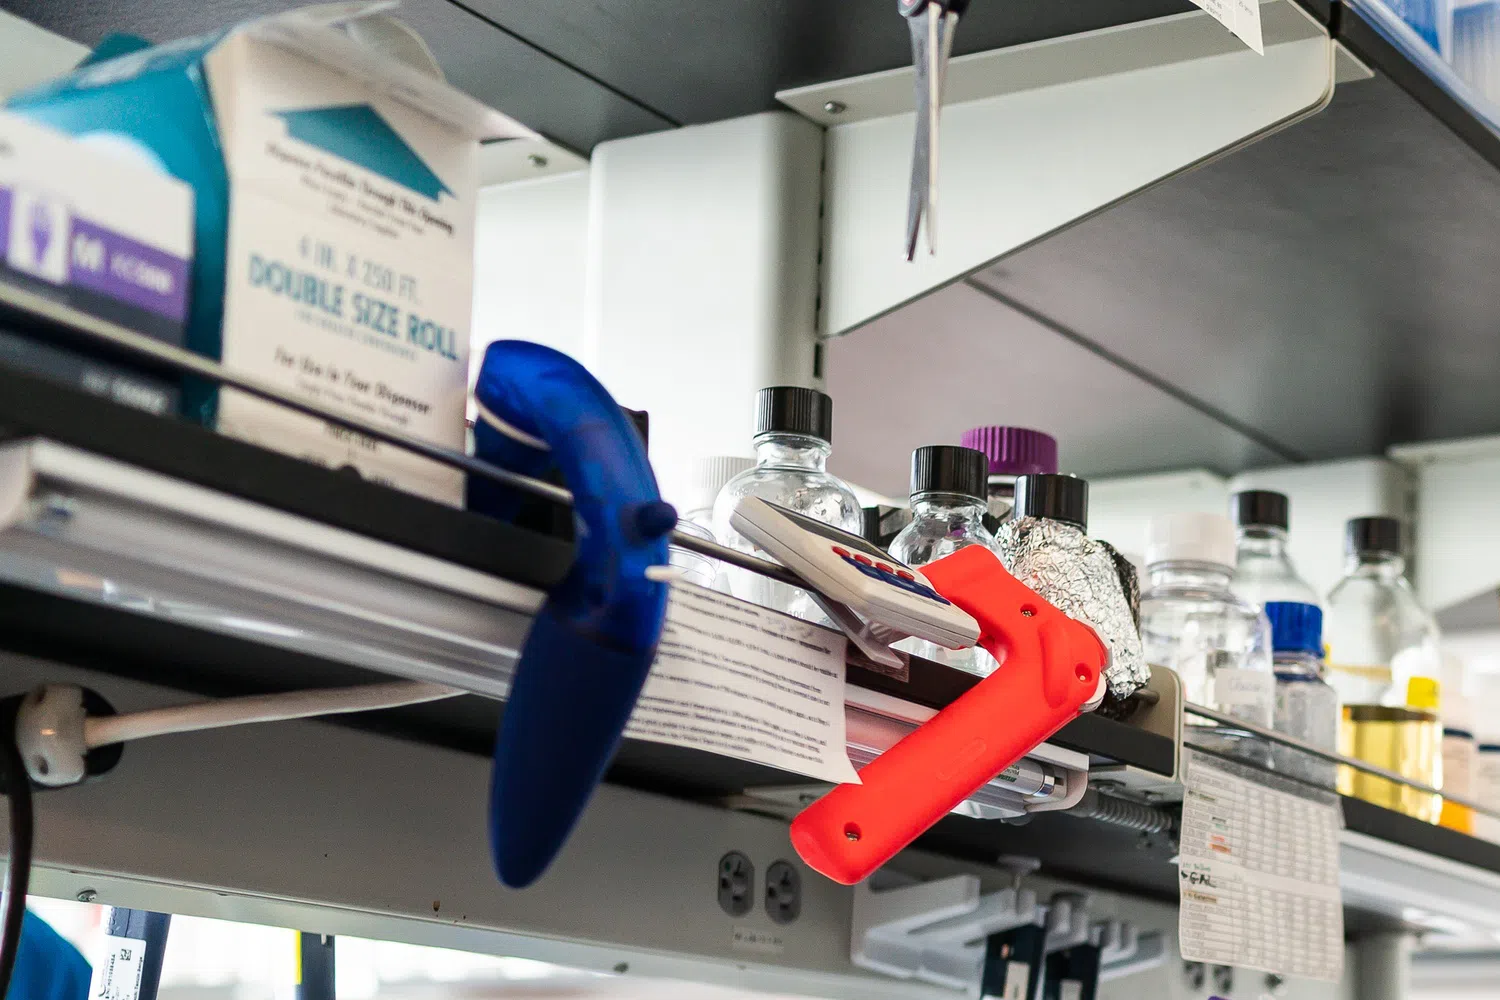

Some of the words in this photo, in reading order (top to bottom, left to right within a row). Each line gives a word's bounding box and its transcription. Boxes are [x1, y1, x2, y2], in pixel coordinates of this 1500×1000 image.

[248, 250, 344, 317] DOUBLE
[351, 291, 401, 339] SIZE
[406, 312, 458, 361] ROLL
